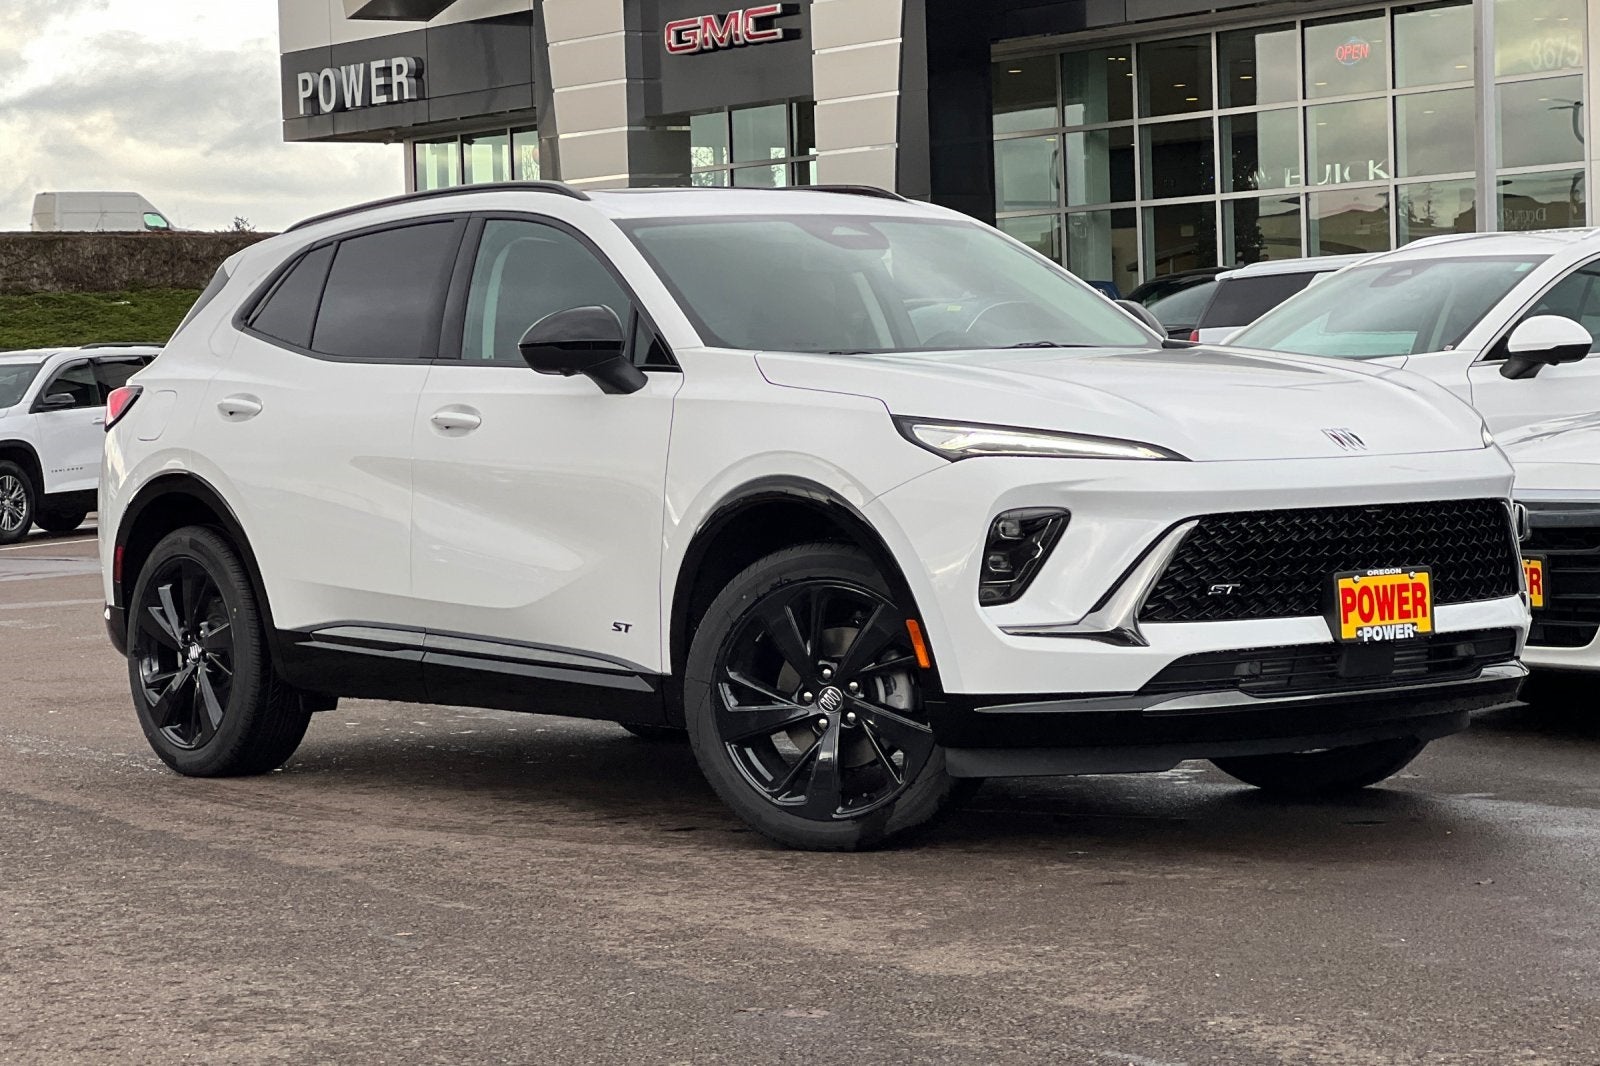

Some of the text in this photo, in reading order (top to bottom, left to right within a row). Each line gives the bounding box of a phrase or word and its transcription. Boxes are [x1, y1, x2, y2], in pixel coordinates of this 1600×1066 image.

[664, 2, 783, 55] GMC
[1335, 43, 1369, 61] OPEN
[297, 56, 409, 115] POWER
[1366, 568, 1402, 576] OREGON
[1208, 583, 1240, 596] ST
[1341, 582, 1427, 624] POWER
[611, 621, 633, 633] ST
[1363, 623, 1414, 642] POWER
